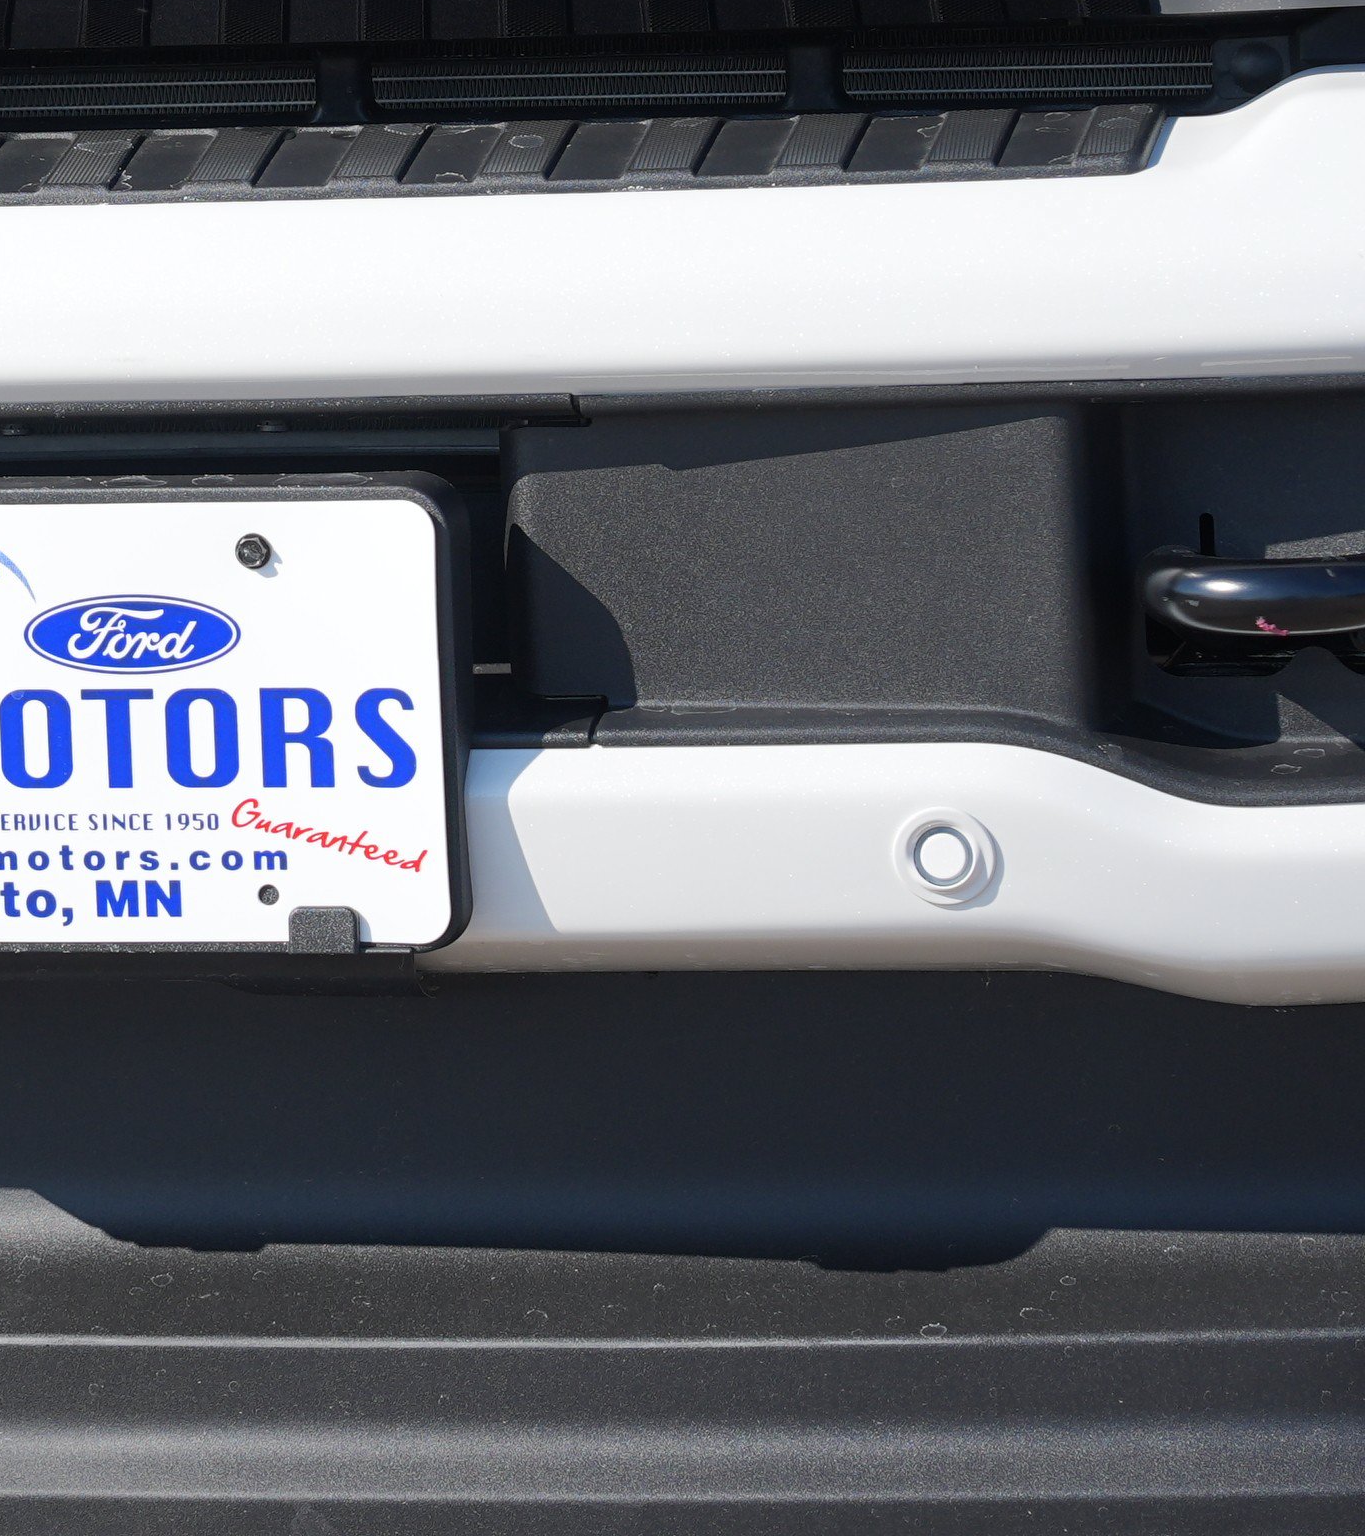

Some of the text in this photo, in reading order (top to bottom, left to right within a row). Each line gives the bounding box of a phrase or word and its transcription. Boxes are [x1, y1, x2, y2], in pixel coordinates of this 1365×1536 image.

[67, 606, 198, 660] Ford
[88, 813, 154, 831] SINCE
[165, 813, 220, 831] 1950
[230, 797, 429, 873] Guaranteed
[95, 879, 183, 918] MN
